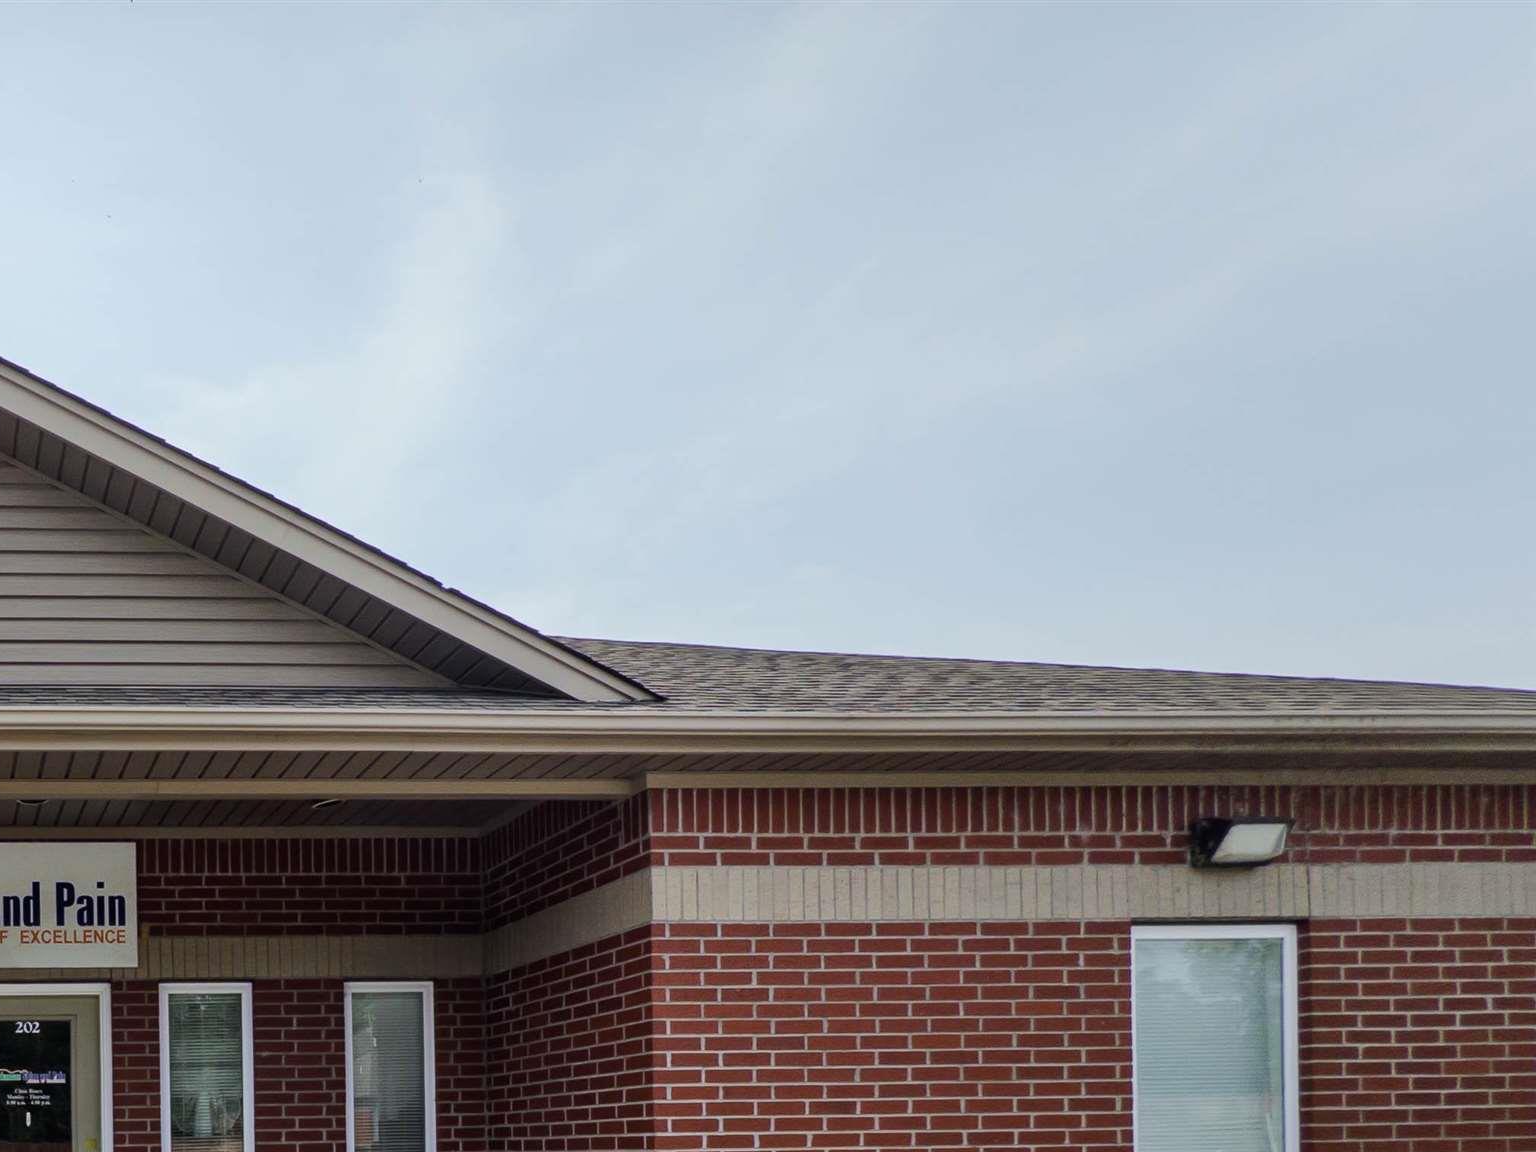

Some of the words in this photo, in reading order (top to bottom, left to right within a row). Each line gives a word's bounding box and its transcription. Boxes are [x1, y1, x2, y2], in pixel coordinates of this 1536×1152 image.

[55, 881, 126, 927] Pain
[20, 929, 126, 944] EXCELLENCE
[15, 1021, 41, 1033] 202
